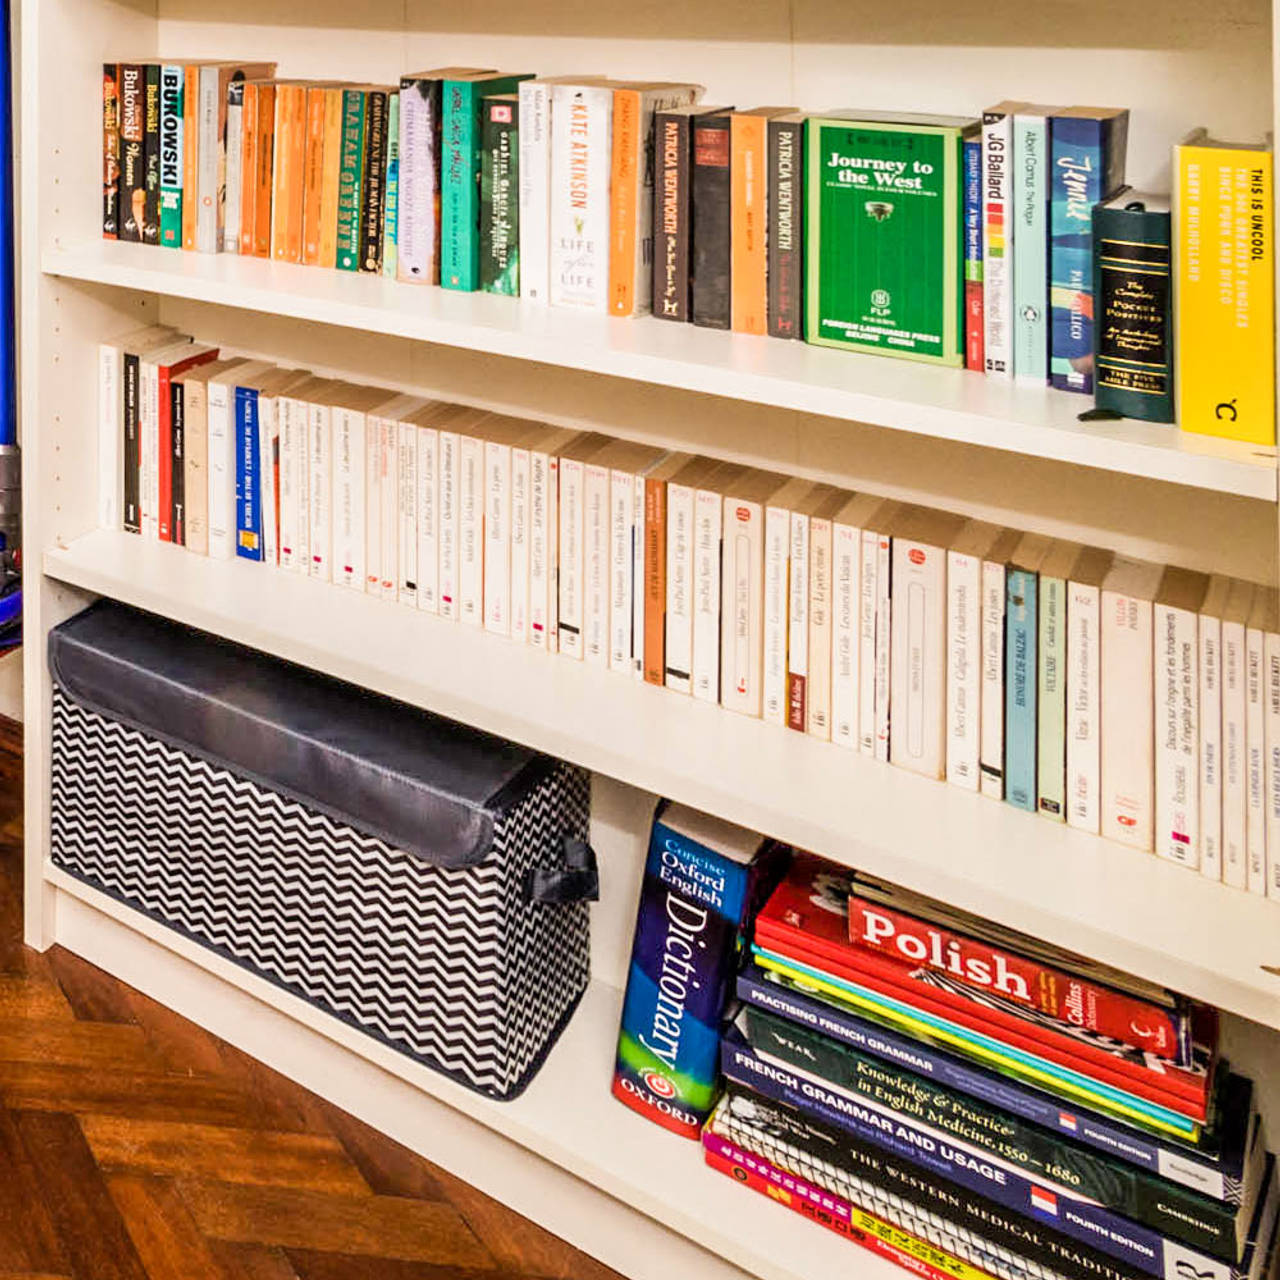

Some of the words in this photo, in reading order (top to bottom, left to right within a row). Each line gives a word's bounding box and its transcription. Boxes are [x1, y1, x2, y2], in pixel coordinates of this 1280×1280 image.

[104, 81, 116, 132] Bukowski
[121, 70, 139, 140] Bukowski
[146, 84, 159, 133] Bukowski
[569, 103, 589, 138] KATE
[162, 73, 179, 186] BUKOWSKI
[344, 91, 360, 169] GRAHAM
[404, 100, 415, 174] CHIMAMANDA
[499, 131, 509, 175] GABRIEL
[663, 122, 678, 167] PATRICIA
[987, 132, 1004, 152] JG
[1025, 130, 1037, 156] Albert
[125, 142, 140, 187] Women
[569, 140, 589, 210] ATKINSON
[778, 131, 793, 180] PATRICIA
[827, 152, 907, 175] Journey
[913, 160, 934, 175] to
[987, 153, 1004, 200] Ballard
[1025, 157, 1037, 188] Camus
[404, 178, 415, 212] NGOZI
[663, 168, 678, 233] WENTWORTH
[838, 169, 869, 185] the
[872, 171, 923, 190] West
[1056, 154, 1093, 222] Jennie
[1250, 168, 1264, 195] THIS
[778, 181, 793, 250] WENTWORTH
[1250, 198, 1264, 212] IS
[1250, 214, 1264, 262] UNCOOL
[1126, 281, 1144, 291] The
[870, 307, 891, 317] FLP
[660, 851, 726, 892] Oxford
[665, 838, 726, 874] Concise
[659, 866, 724, 908] English
[861, 909, 1032, 1001] Polish
[638, 892, 709, 1073] Dictionary
[1065, 981, 1084, 1026] Collins
[770, 1031, 817, 1062] WEAR
[750, 989, 819, 1024] PRACTISING
[819, 1016, 867, 1044] FRENCH
[867, 1036, 933, 1072] GRAMMAR
[1083, 1128, 1117, 1147] FOURTH
[1117, 1140, 1152, 1161] EDITION
[856, 1061, 932, 1104] Knowledge
[932, 1094, 951, 1108] &
[619, 1077, 699, 1127] OXFORD
[733, 1051, 799, 1094] FRENCH
[801, 1084, 895, 1135] GRAMMAR
[894, 1124, 937, 1152] AND
[939, 1146, 1008, 1188] USAGE
[1065, 1211, 1109, 1238] FOURTH
[1109, 1231, 1155, 1258] EDITION
[857, 1079, 872, 1091] in
[872, 1084, 925, 1119] English
[927, 1109, 996, 1152] Medicine,
[998, 1141, 1029, 1164] 1550
[1044, 1162, 1083, 1186] 1680
[849, 1148, 881, 1170] THE
[887, 1165, 963, 1208] WESTERN
[965, 1200, 1043, 1247] MEDICAL
